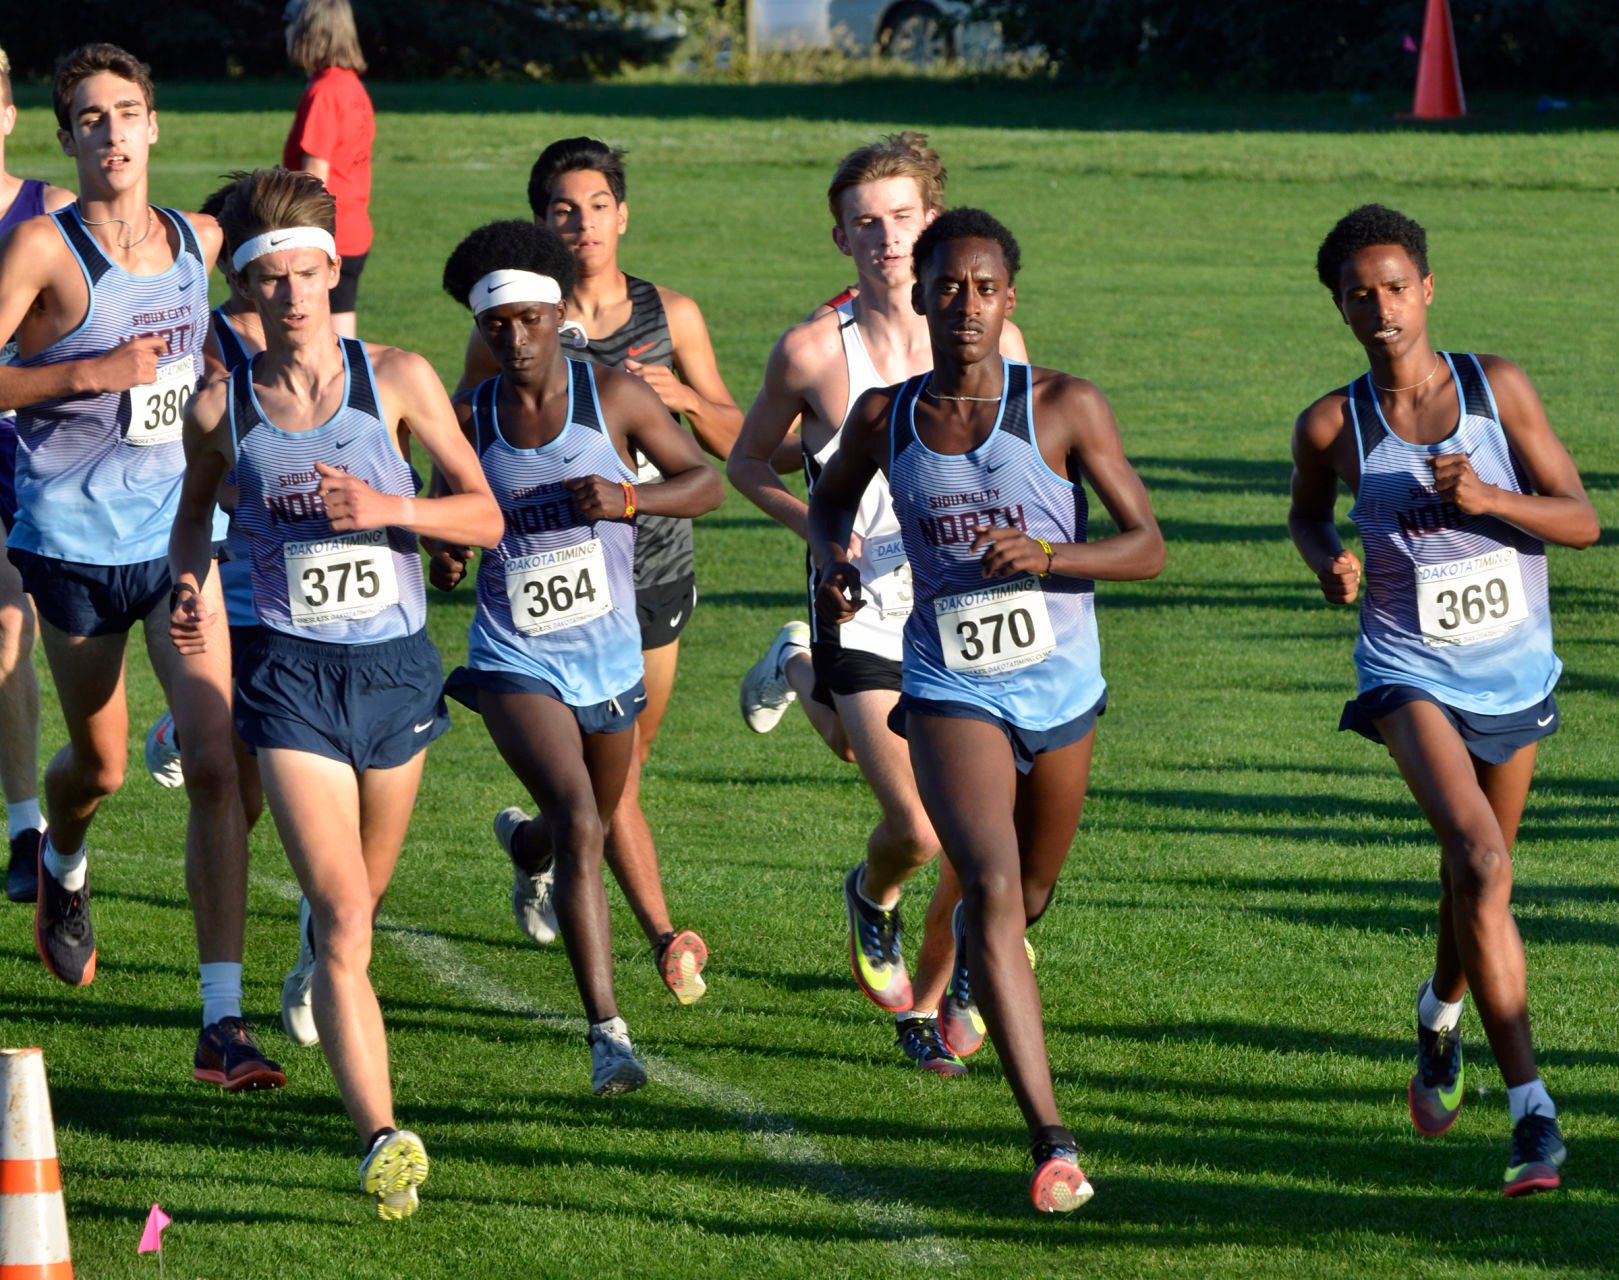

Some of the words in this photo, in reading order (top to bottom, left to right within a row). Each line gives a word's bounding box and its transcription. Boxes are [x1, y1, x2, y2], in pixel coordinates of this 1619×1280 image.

[132, 311, 164, 327] SIOUX
[167, 304, 192, 320] CITY
[144, 384, 191, 430] 380
[278, 470, 319, 488] SIOUX
[930, 493, 968, 508] SIOUX
[971, 488, 1001, 504] CITY
[504, 500, 576, 535] NORT
[1397, 502, 1463, 538] NOR
[302, 559, 380, 607] 375
[523, 568, 597, 618] 364
[1436, 578, 1510, 630] 369
[956, 608, 1036, 661] 370
